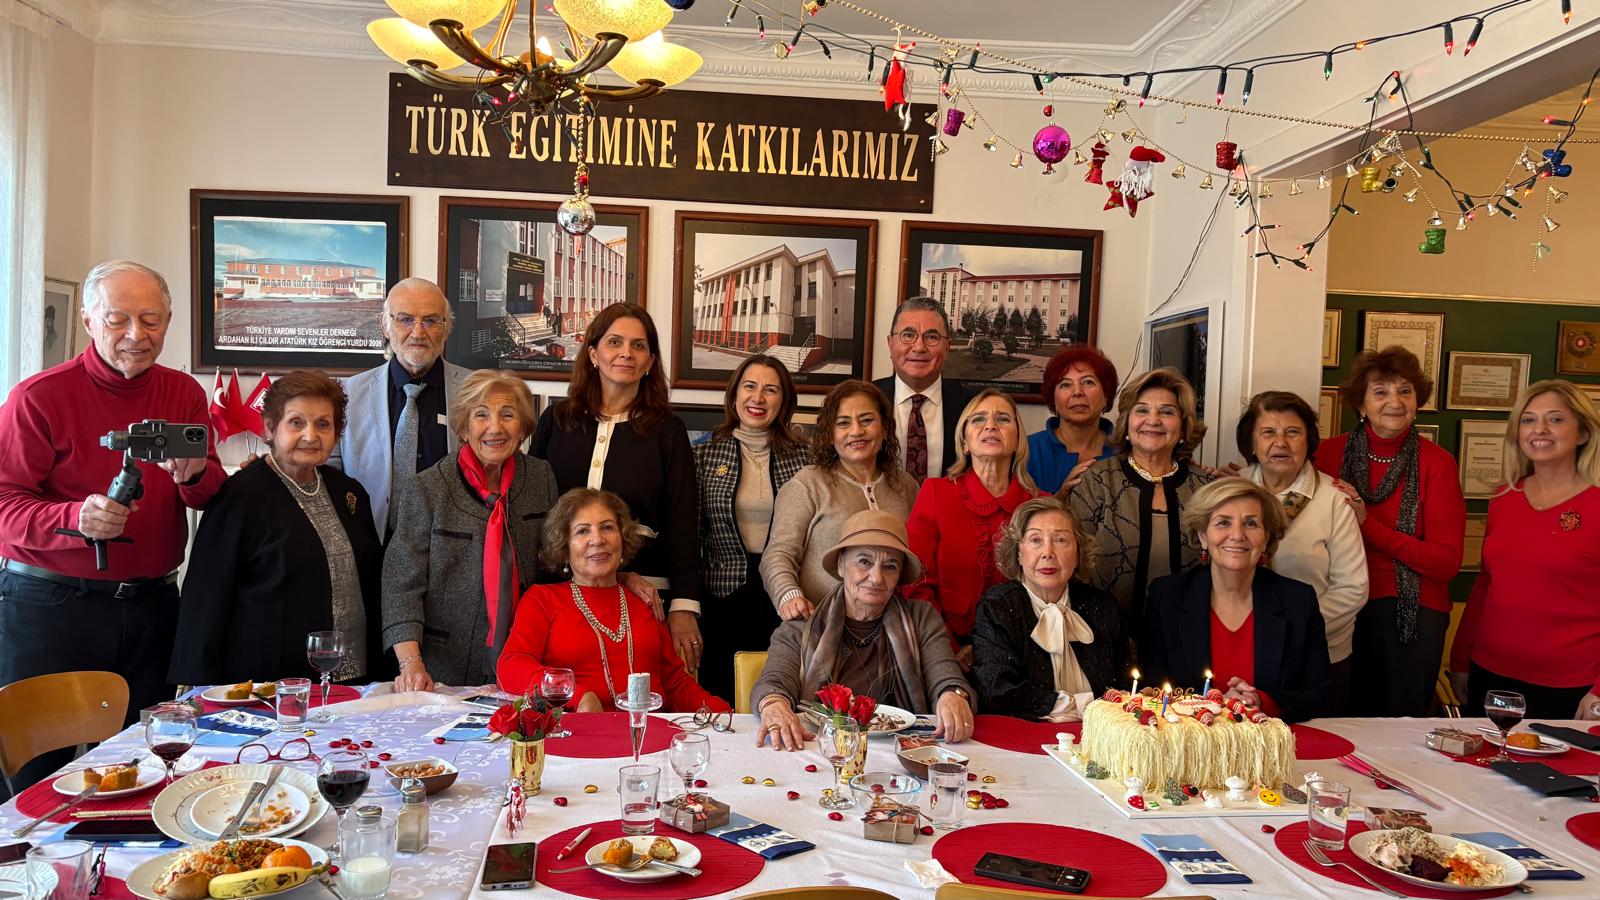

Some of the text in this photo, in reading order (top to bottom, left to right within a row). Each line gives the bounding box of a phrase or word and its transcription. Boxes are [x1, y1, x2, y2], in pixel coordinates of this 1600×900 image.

[406, 93, 491, 157] TÜRK
[695, 121, 920, 182] KATKILARIMIZ
[246, 325, 357, 337] TÜRKİYE YARDIM SEVENLER DERNEĞİ
[218, 335, 249, 344] ARDAHAN
[279, 336, 307, 346] ATATÜRK
[307, 337, 318, 346] KIZ
[318, 336, 347, 347] ÖĞRENCİ
[347, 338, 368, 347] YURDU
